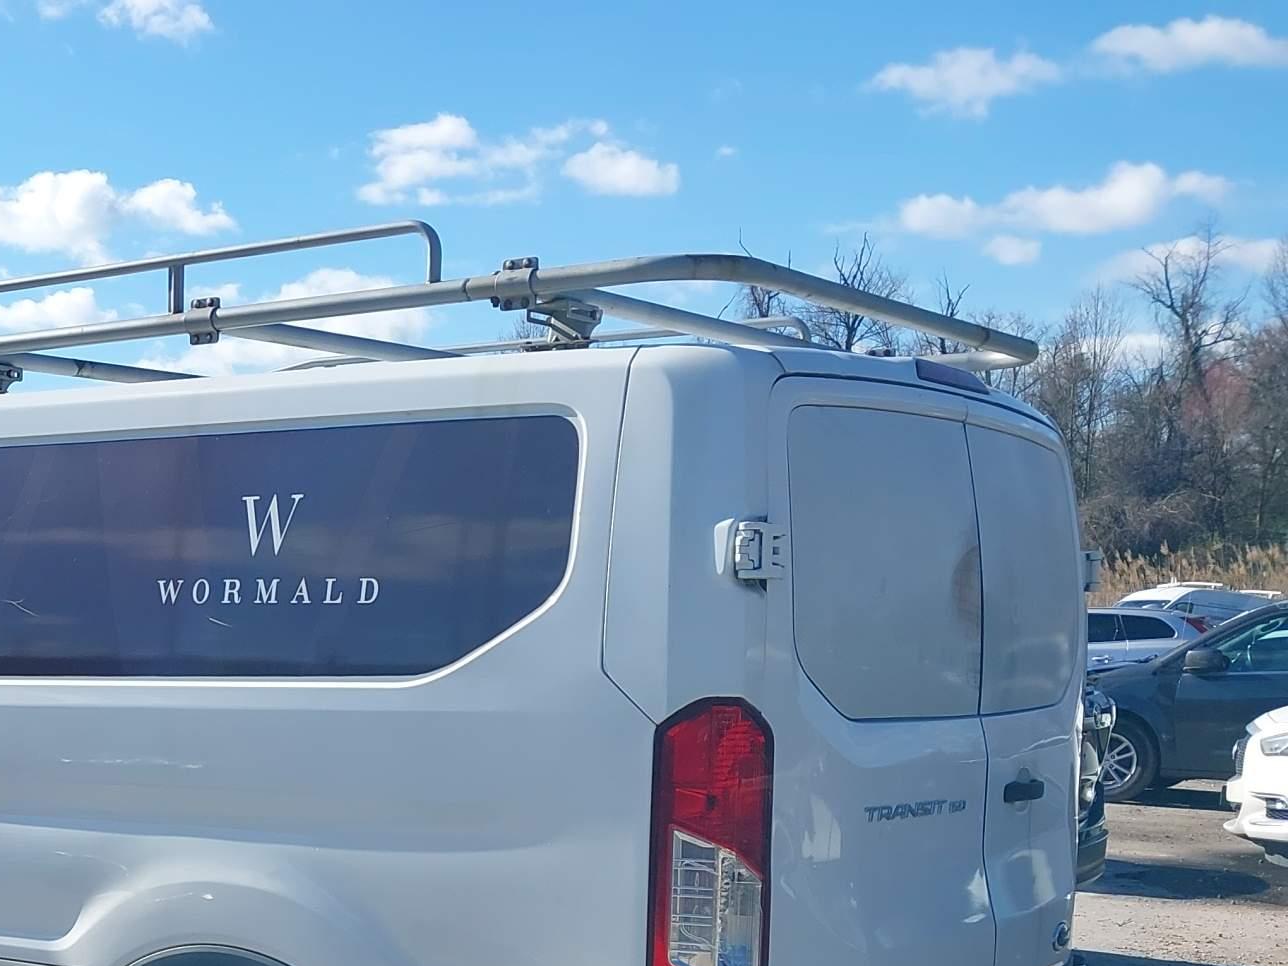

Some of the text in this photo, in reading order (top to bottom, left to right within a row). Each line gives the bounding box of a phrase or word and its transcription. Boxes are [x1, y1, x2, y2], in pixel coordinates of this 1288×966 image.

[242, 493, 305, 557] W
[157, 577, 380, 605] WORMALD
[864, 799, 948, 822] TRANSIT
